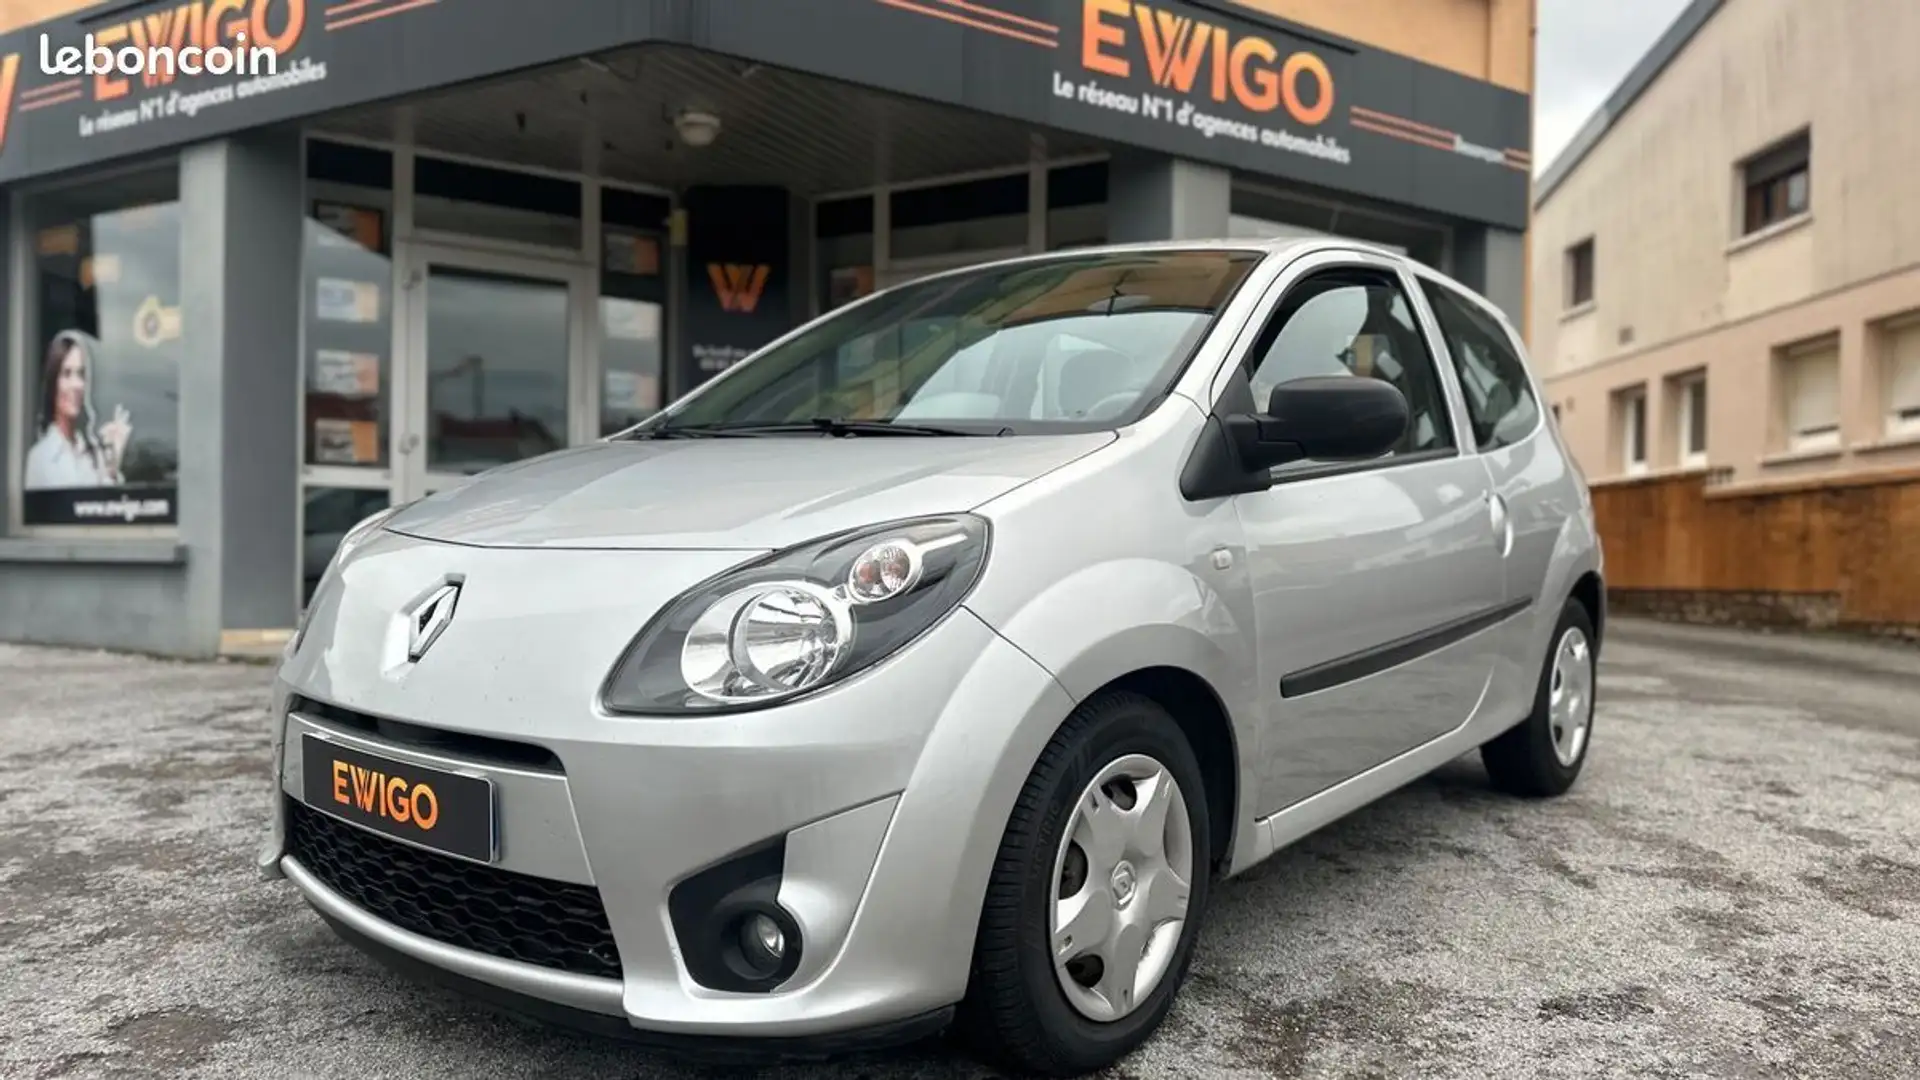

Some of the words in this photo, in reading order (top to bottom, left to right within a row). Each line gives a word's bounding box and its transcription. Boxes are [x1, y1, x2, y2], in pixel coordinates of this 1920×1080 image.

[94, 0, 307, 101] EWIGO
[236, 57, 327, 99] automobiles
[1082, 0, 1334, 126] EWIGO
[1052, 71, 1075, 98] Le
[1077, 81, 1139, 117] réseau
[1141, 93, 1174, 123] N°1
[1175, 101, 1258, 142] d'agences
[1260, 126, 1351, 165] automobiles
[333, 759, 439, 830] EWIGO
